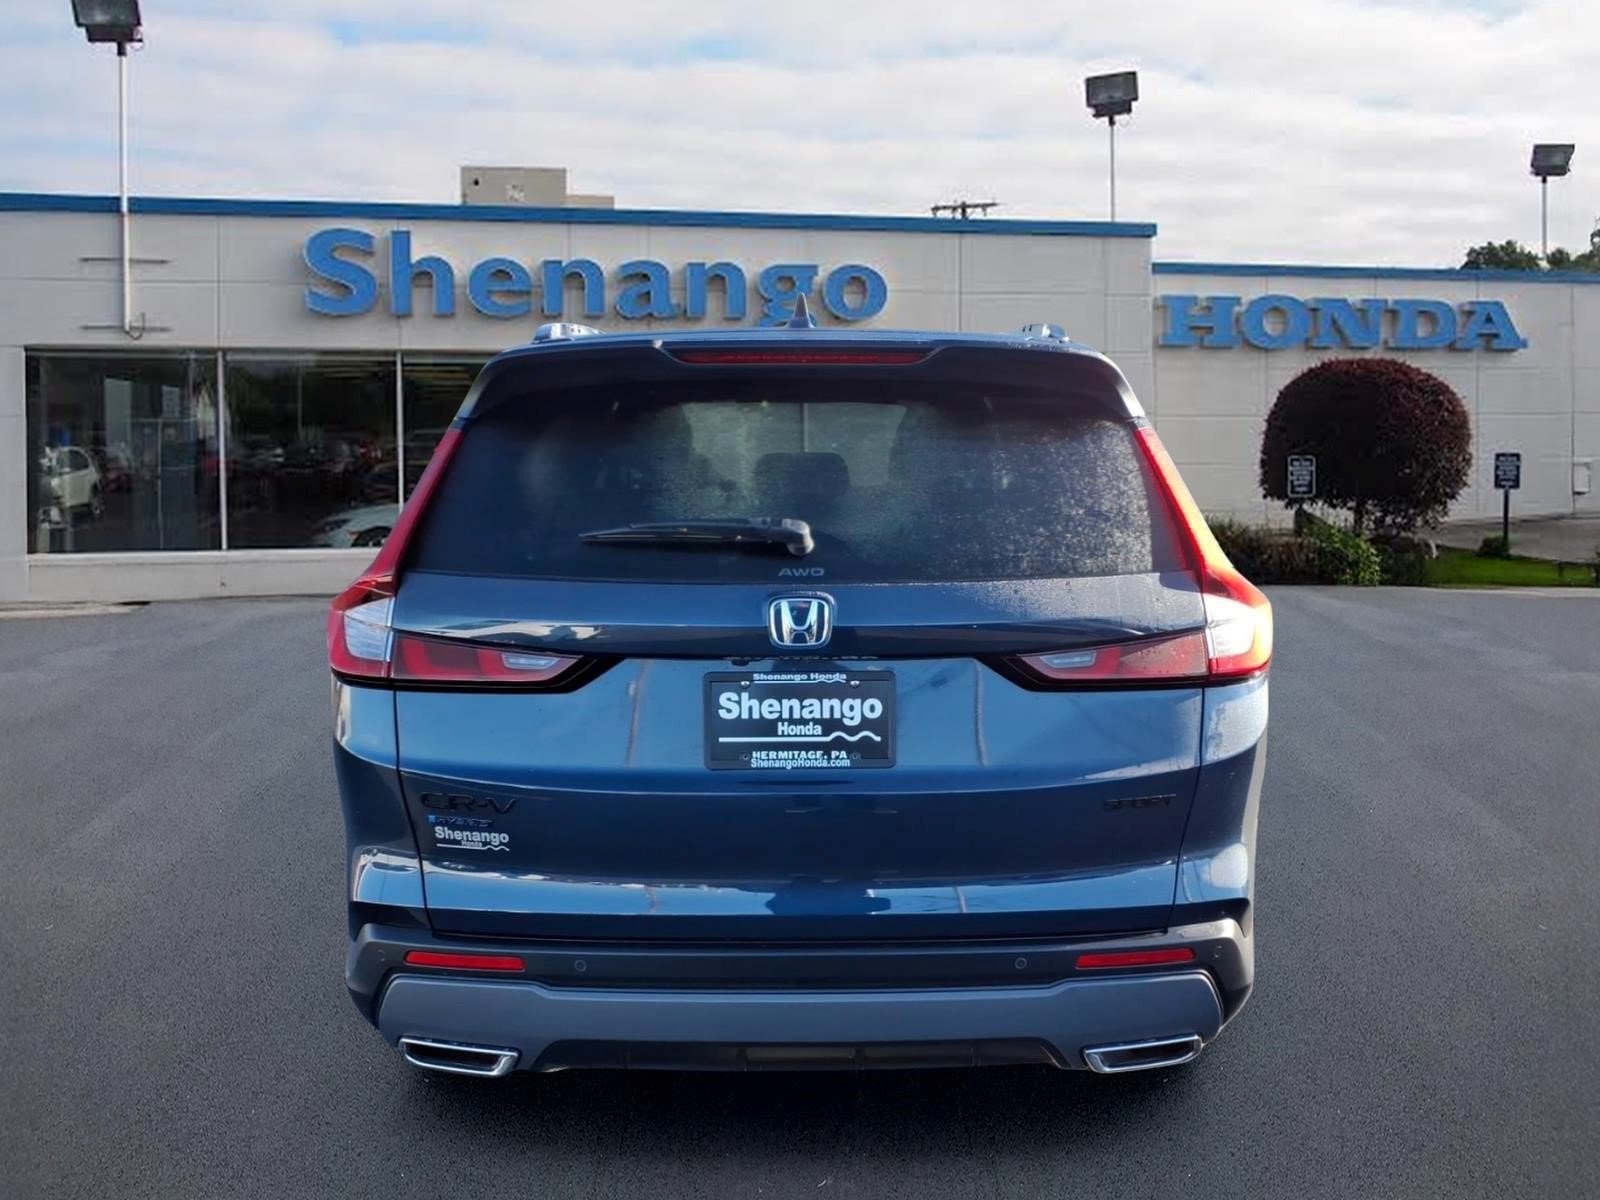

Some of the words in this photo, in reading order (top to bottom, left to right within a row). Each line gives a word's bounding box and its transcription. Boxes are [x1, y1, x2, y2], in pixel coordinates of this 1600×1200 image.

[302, 228, 888, 328] Shenango
[1153, 294, 1528, 352] HONDA
[778, 567, 825, 577] AWD
[753, 673, 808, 681] Shenango
[810, 673, 847, 681] Honda
[718, 692, 883, 727] Shenango
[777, 722, 822, 736] Honda
[831, 751, 847, 759] PA
[750, 758, 850, 770] ShenangoHonda.com
[420, 791, 516, 814] CR-V
[434, 826, 510, 846] Shenango
